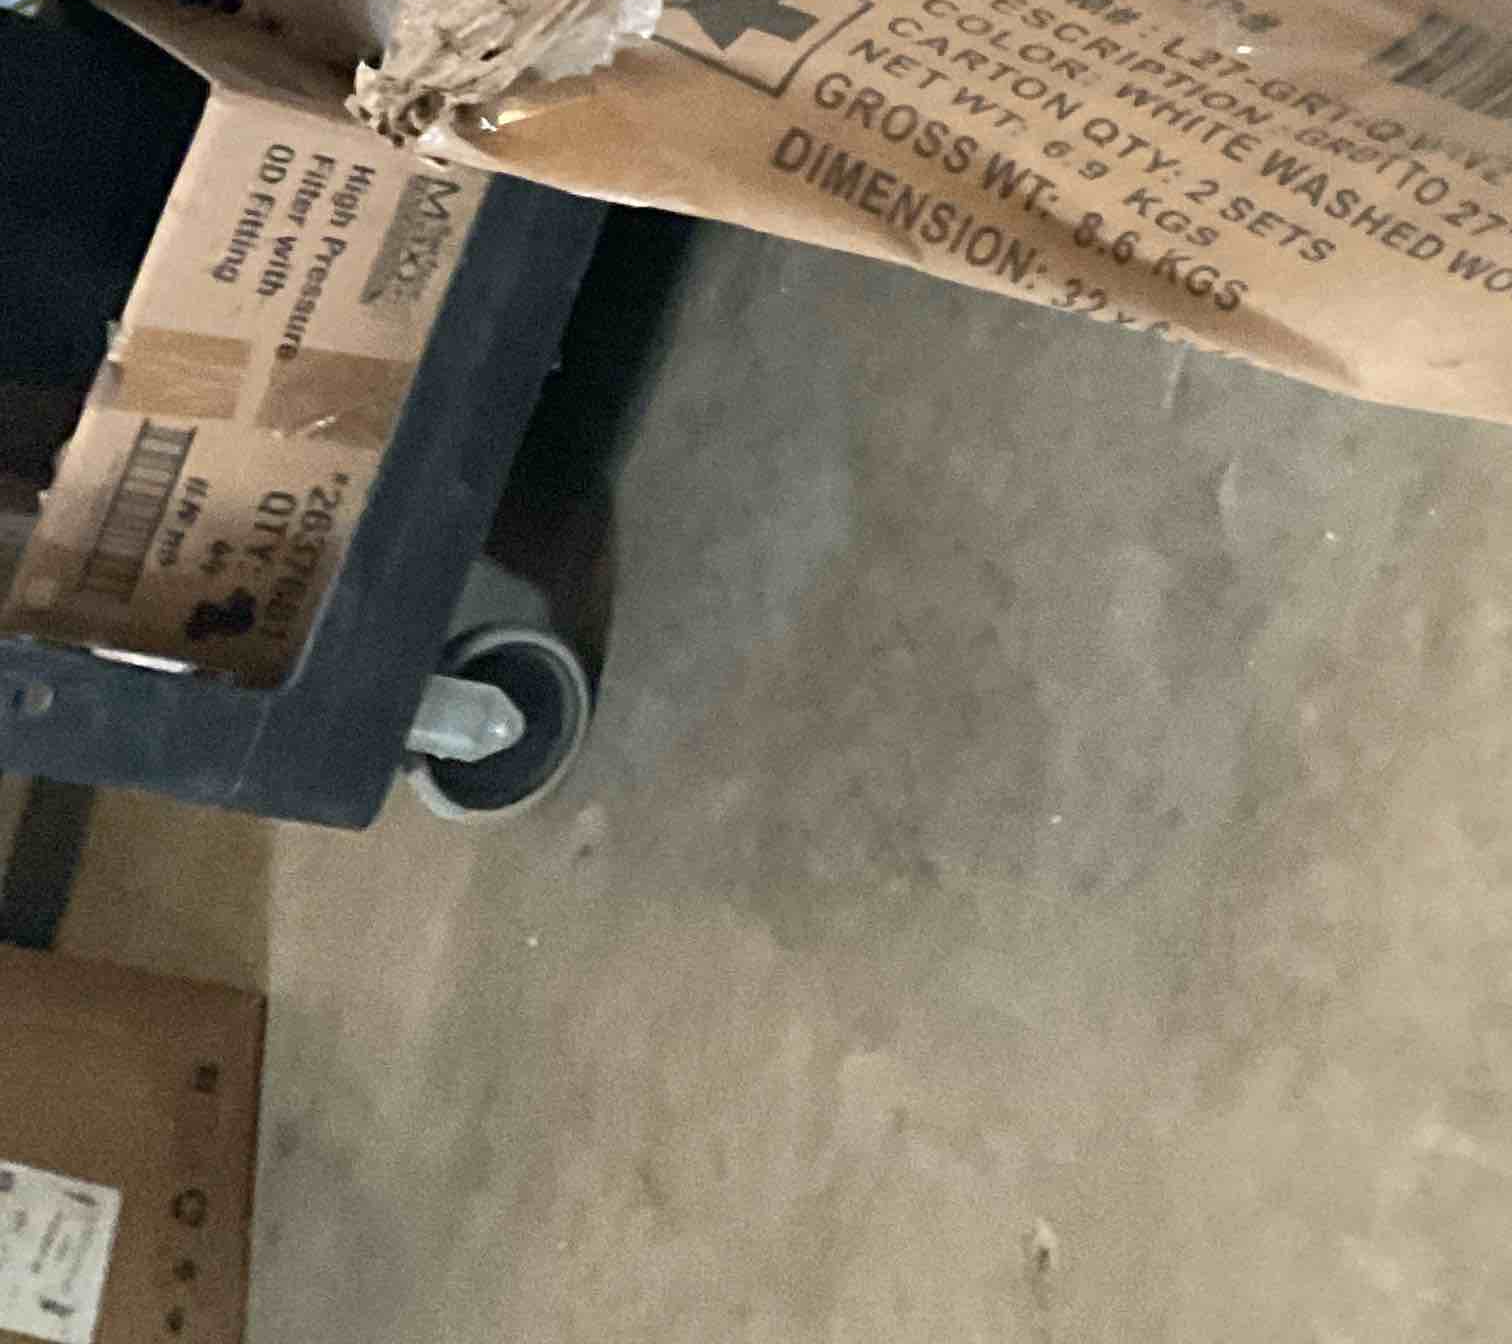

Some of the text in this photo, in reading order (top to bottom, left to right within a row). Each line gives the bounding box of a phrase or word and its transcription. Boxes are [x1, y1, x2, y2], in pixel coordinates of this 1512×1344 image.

[257, 152, 340, 298] Filter with
[769, 125, 1049, 291] DIMENSION:
[812, 71, 981, 176] GROSS
[1151, 247, 1249, 312] KGS
[849, 38, 951, 99] NET
[1122, 186, 1221, 247] KGS
[887, 16, 1086, 121] CARTON
[1183, 178, 1221, 207] 2
[1218, 196, 1338, 266] SETS
[1114, 81, 1263, 163] WHITE
[1259, 146, 1446, 264] WASHED
[212, 191, 276, 286] Fitting
[275, 164, 377, 362] High Pressure
